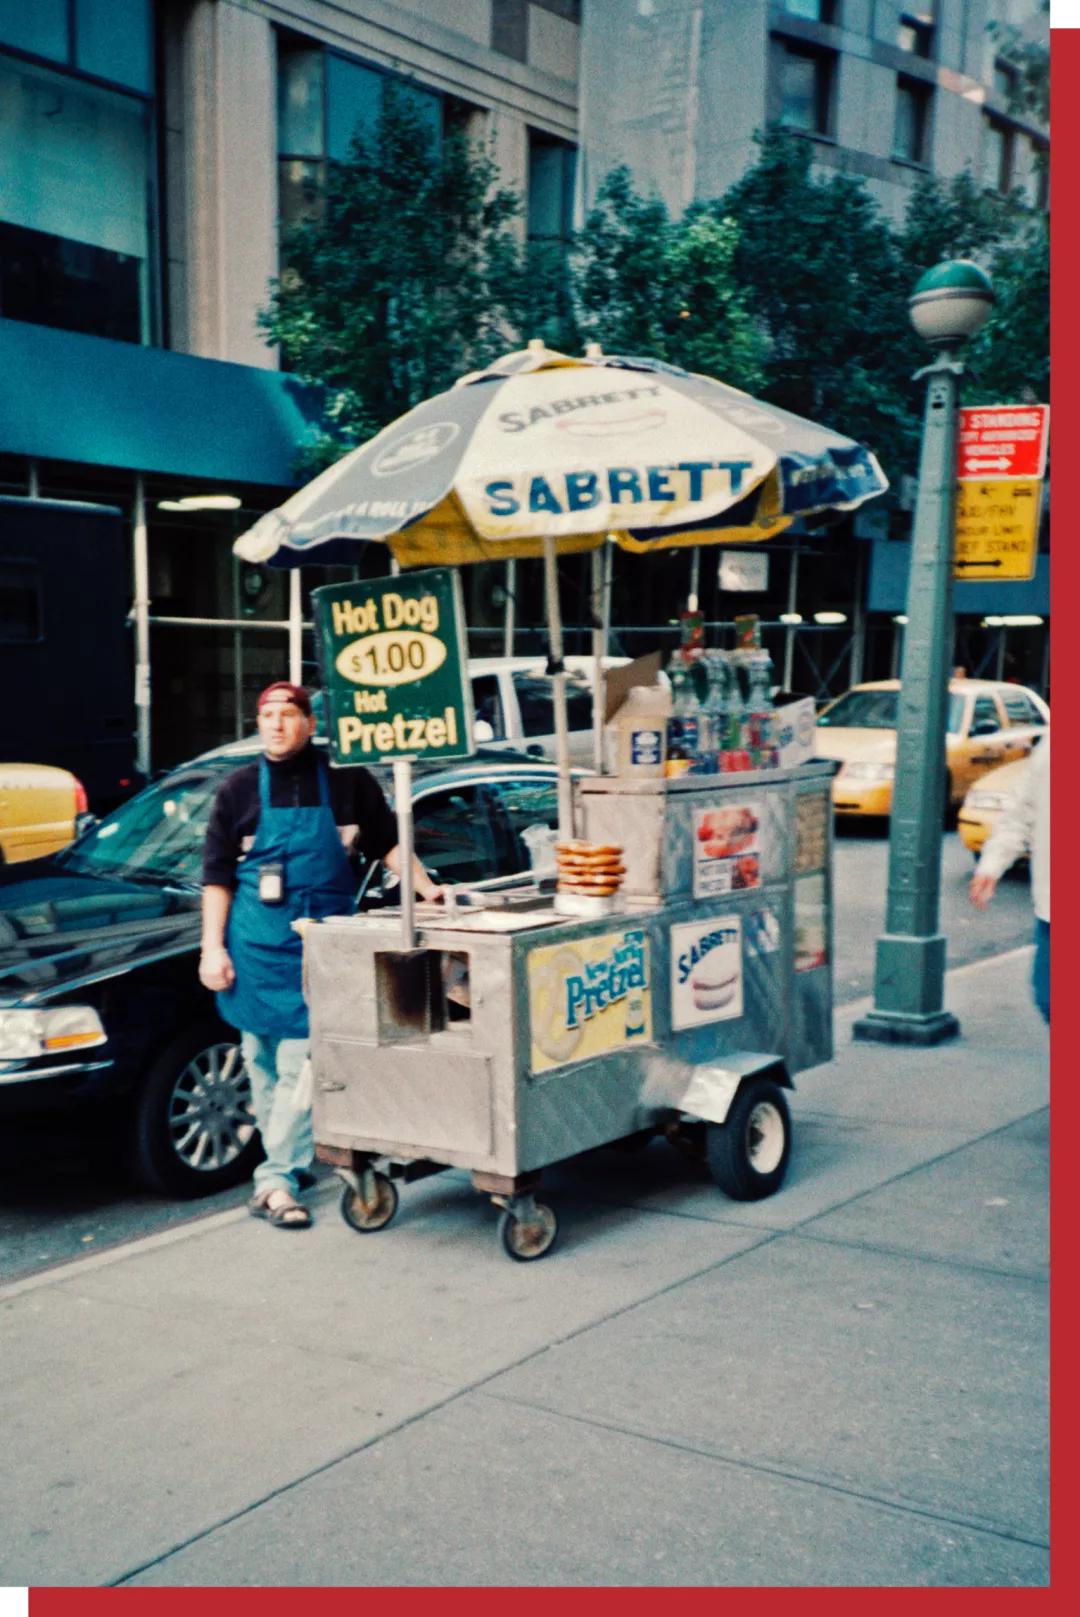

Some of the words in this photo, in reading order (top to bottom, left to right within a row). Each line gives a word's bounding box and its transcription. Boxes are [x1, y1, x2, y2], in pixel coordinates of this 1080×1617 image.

[499, 386, 660, 434] SABRETT
[484, 461, 753, 517] SABRETT
[331, 598, 379, 635] Hot
[382, 592, 439, 632] Dog
[351, 639, 425, 675] $1.00
[353, 689, 387, 713] Hot
[338, 706, 457, 755] Pretzel
[565, 947, 646, 1025] Pretzel
